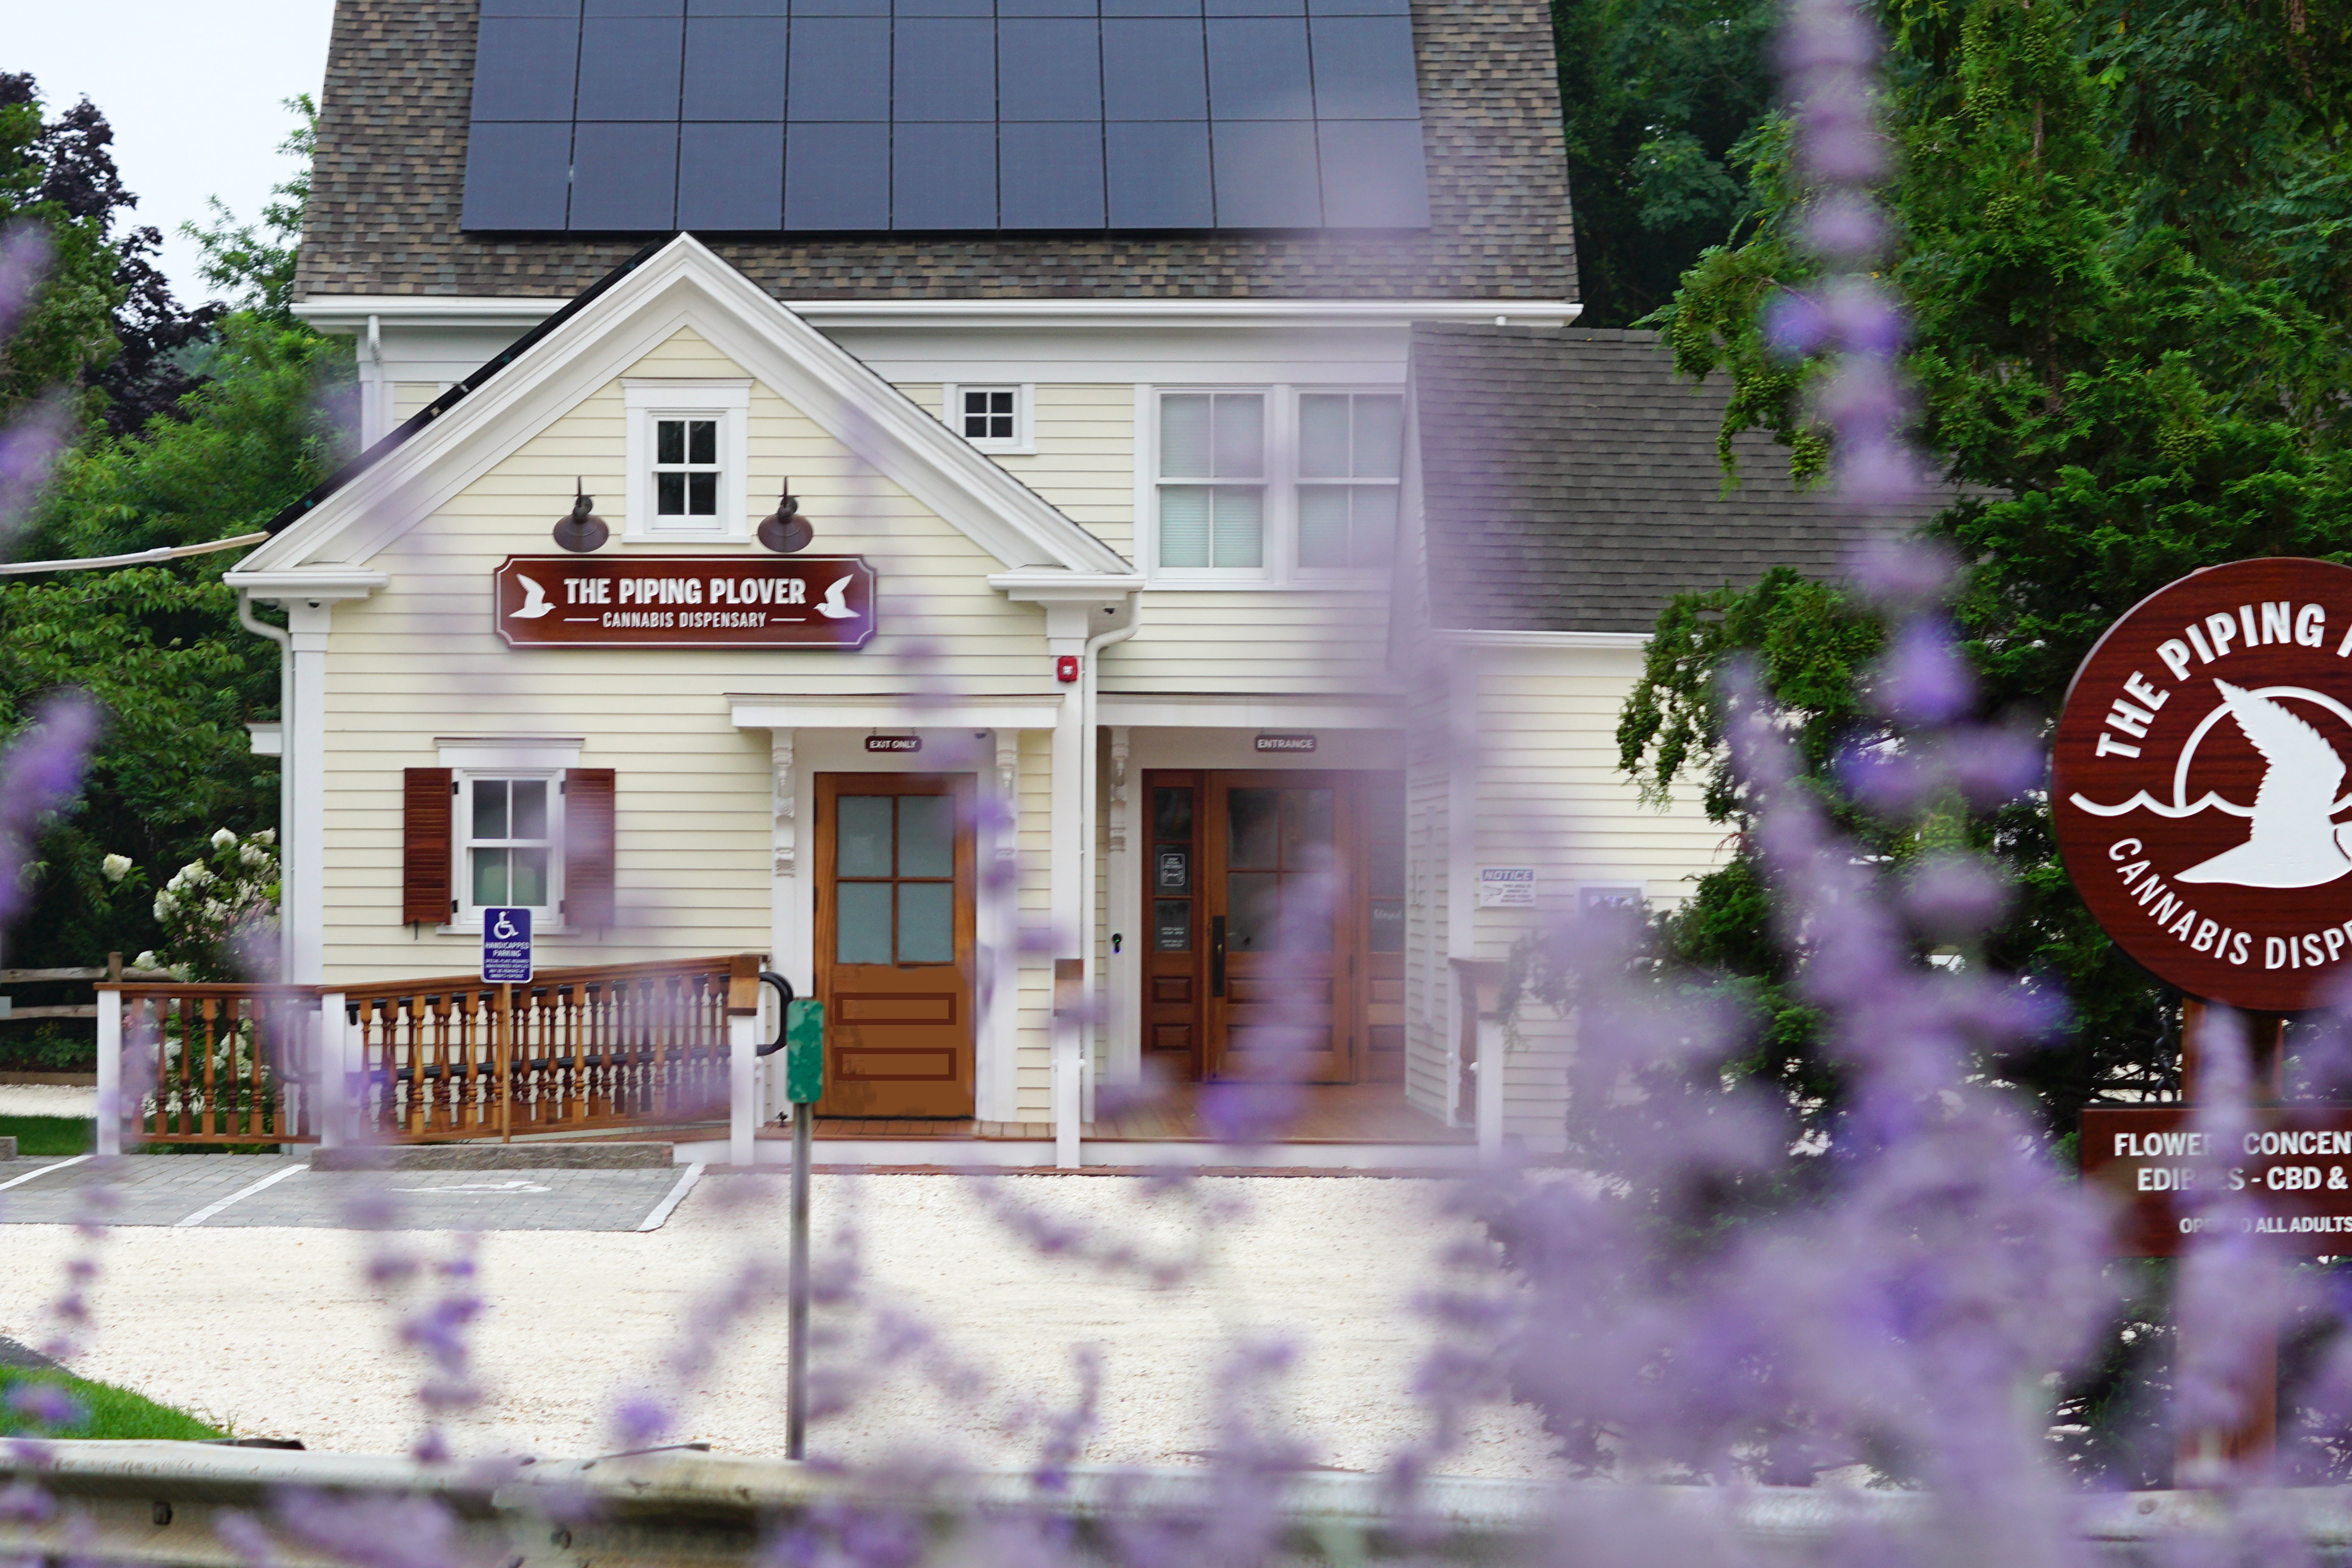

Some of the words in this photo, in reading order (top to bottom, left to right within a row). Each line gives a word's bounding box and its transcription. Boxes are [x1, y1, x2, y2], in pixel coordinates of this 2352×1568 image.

[563, 578, 612, 604] THE
[619, 578, 702, 604] PIPING
[710, 578, 806, 604] PLOVER
[603, 612, 674, 628] CANNABIS
[679, 612, 766, 628] DISPENSARY
[2095, 670, 2170, 759] THE
[2156, 601, 2325, 681] PIPING
[869, 740, 891, 749] EXIT
[891, 740, 917, 749] ONLY
[1257, 739, 1314, 748] ENTRANCE
[1484, 870, 1532, 880] NOTICE
[2108, 837, 2252, 965] CANNABIS
[485, 942, 530, 950] HANDICAPPED
[492, 949, 522, 958] PARKING
[2243, 1131, 2352, 1155] CONCEN
[2138, 1167, 2245, 1191] EDIBS
[2267, 1166, 2322, 1190] CBD
[2327, 1165, 2349, 1190] &
[2255, 1216, 2288, 1233] ALL
